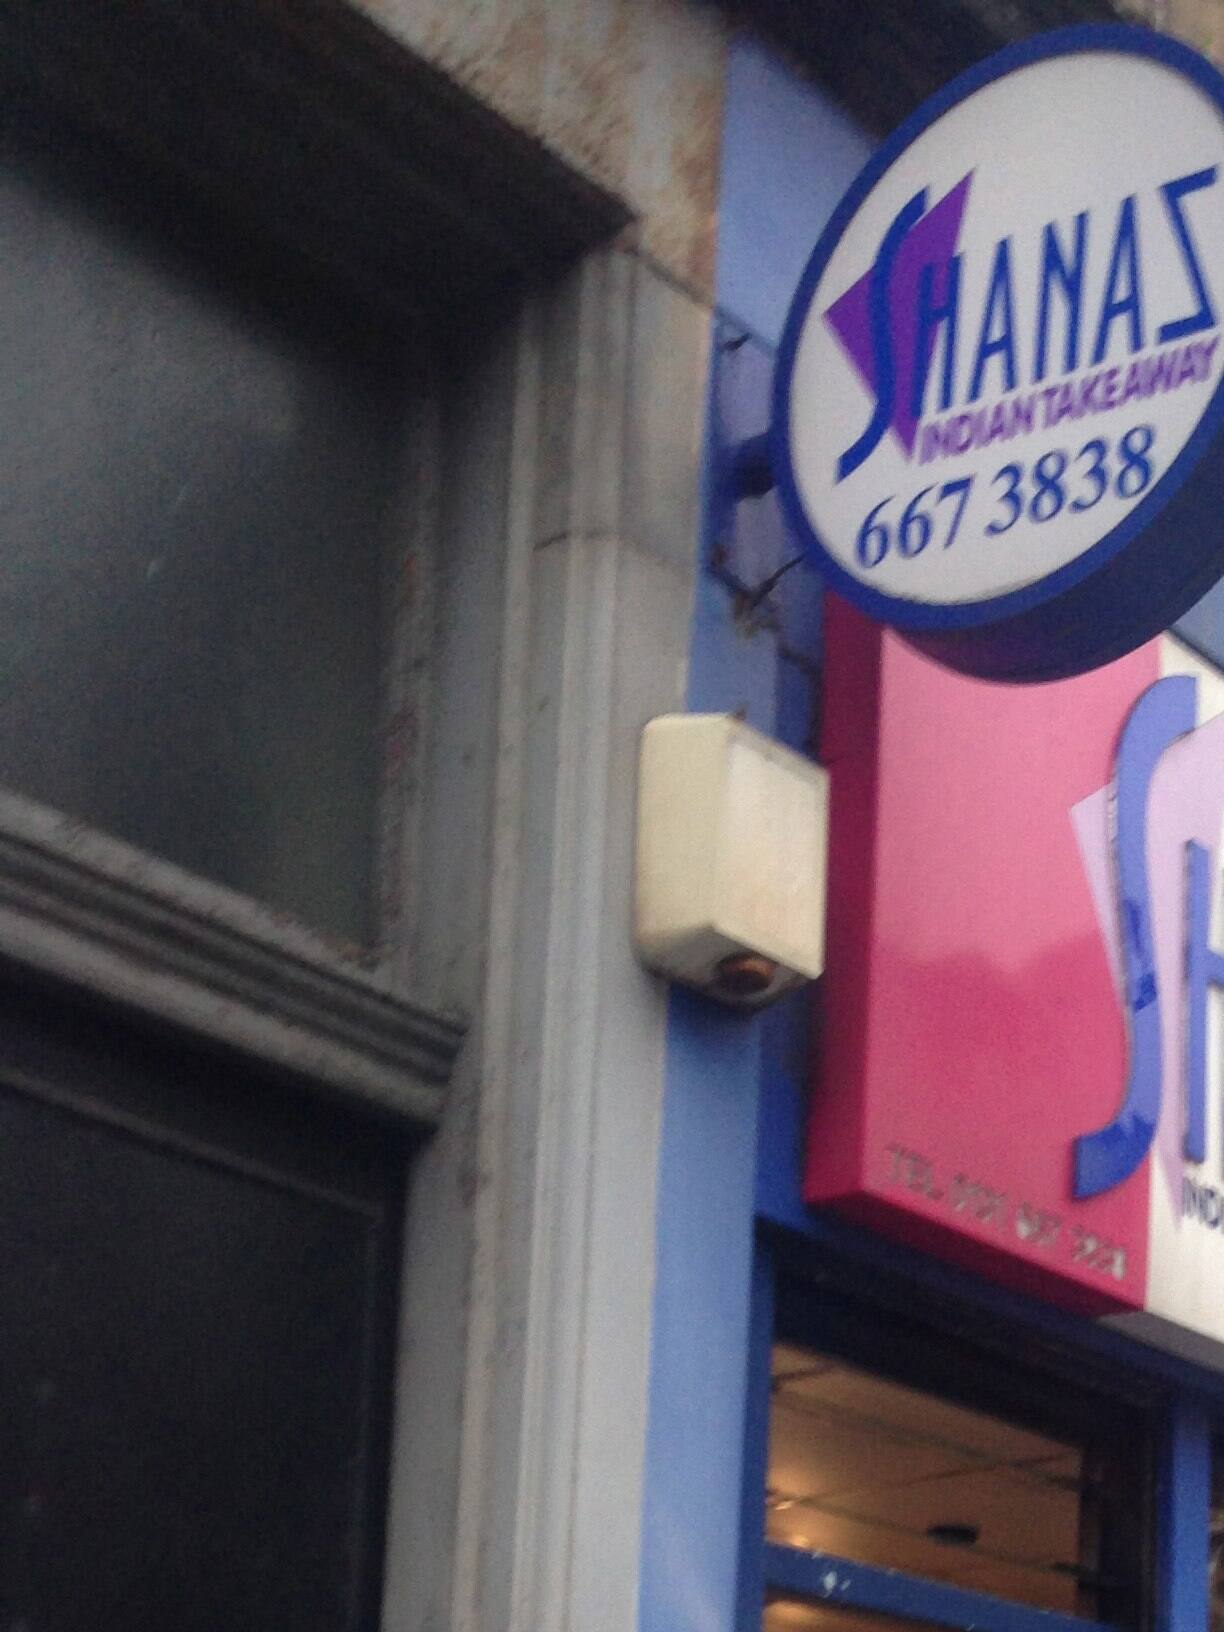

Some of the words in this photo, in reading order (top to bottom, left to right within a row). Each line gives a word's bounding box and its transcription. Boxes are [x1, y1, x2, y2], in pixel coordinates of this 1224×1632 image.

[919, 390, 1037, 465] INDIAN
[1042, 333, 1221, 430] TAKEAWAY
[856, 474, 974, 569] 667
[984, 425, 1155, 537] 3838
